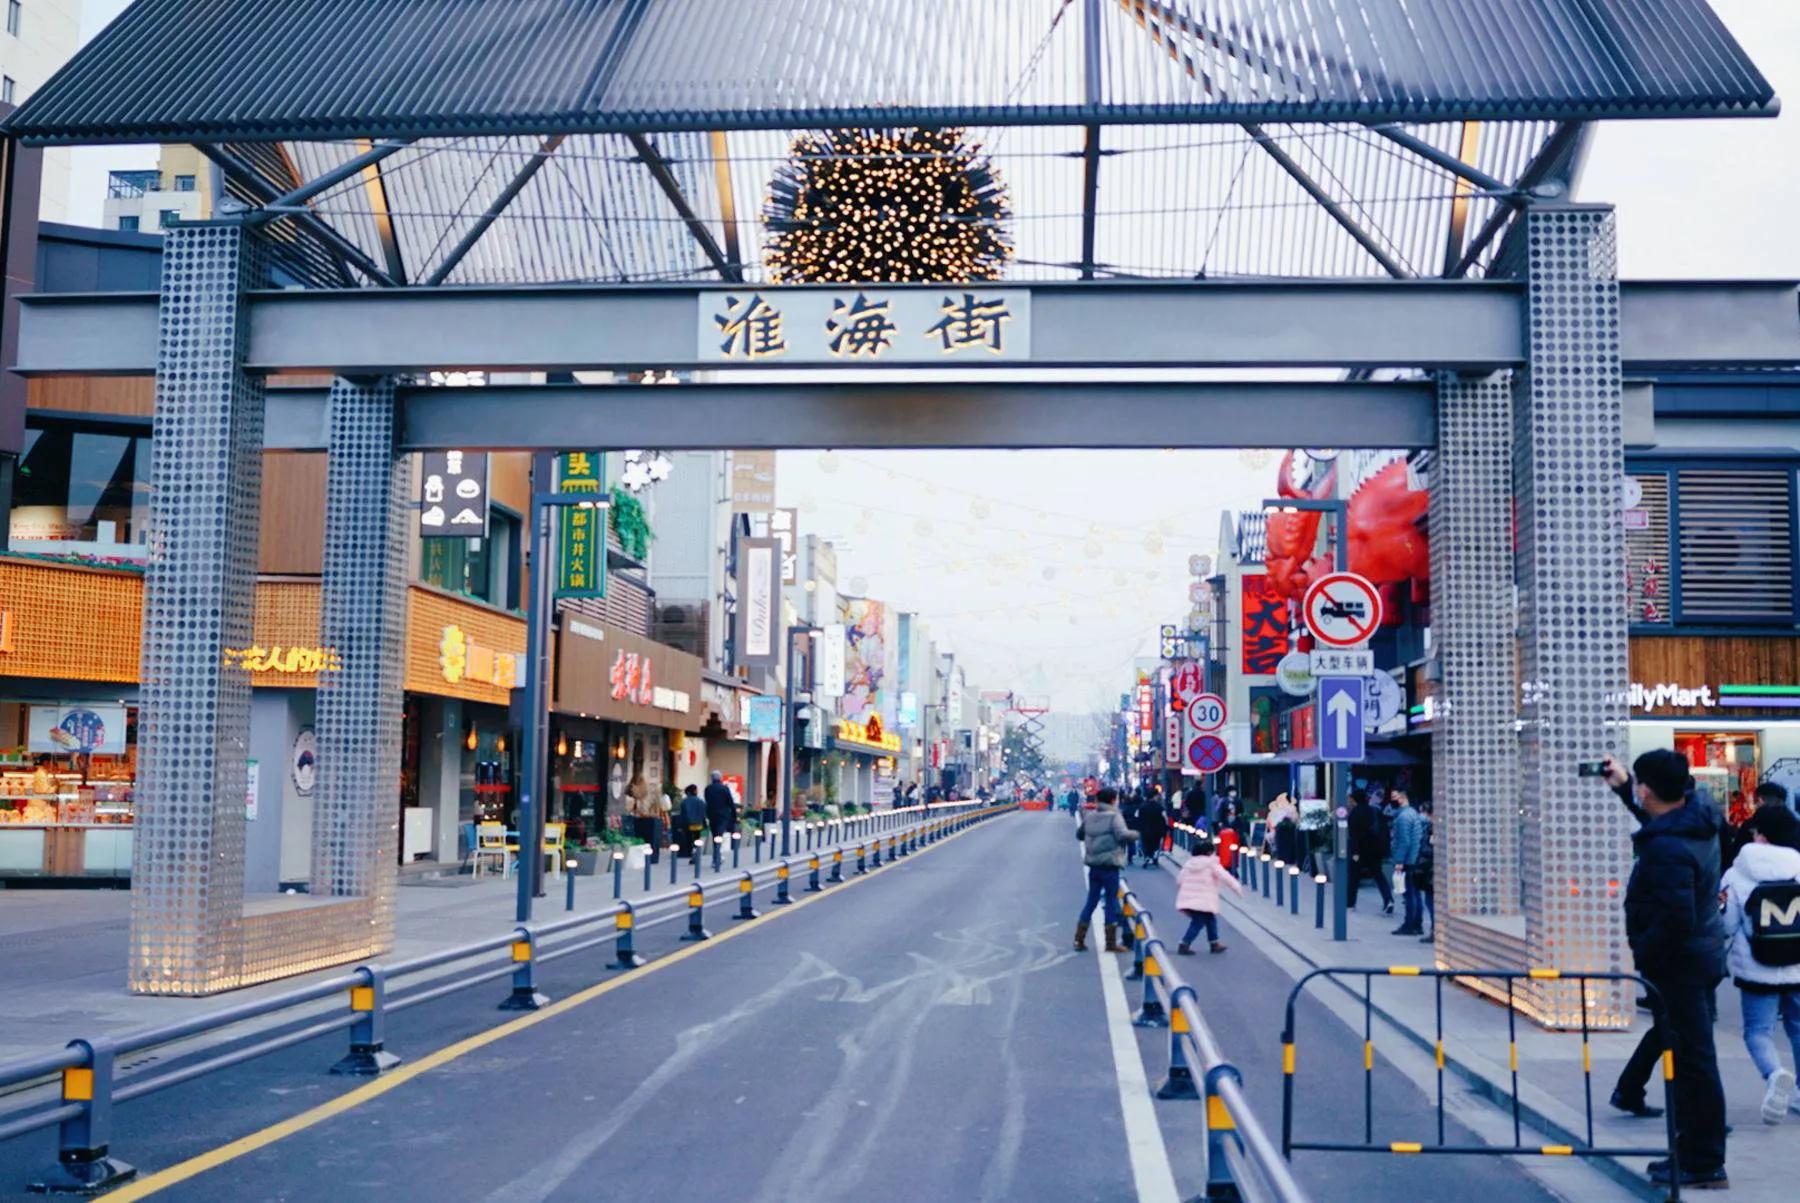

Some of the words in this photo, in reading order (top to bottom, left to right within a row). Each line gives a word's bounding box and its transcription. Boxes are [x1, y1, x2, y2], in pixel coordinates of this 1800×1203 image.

[714, 292, 1011, 360] 淮海街
[570, 505, 587, 588] 都市井火锅
[1315, 656, 1369, 670] 大型车辆
[1197, 705, 1220, 722] 30
